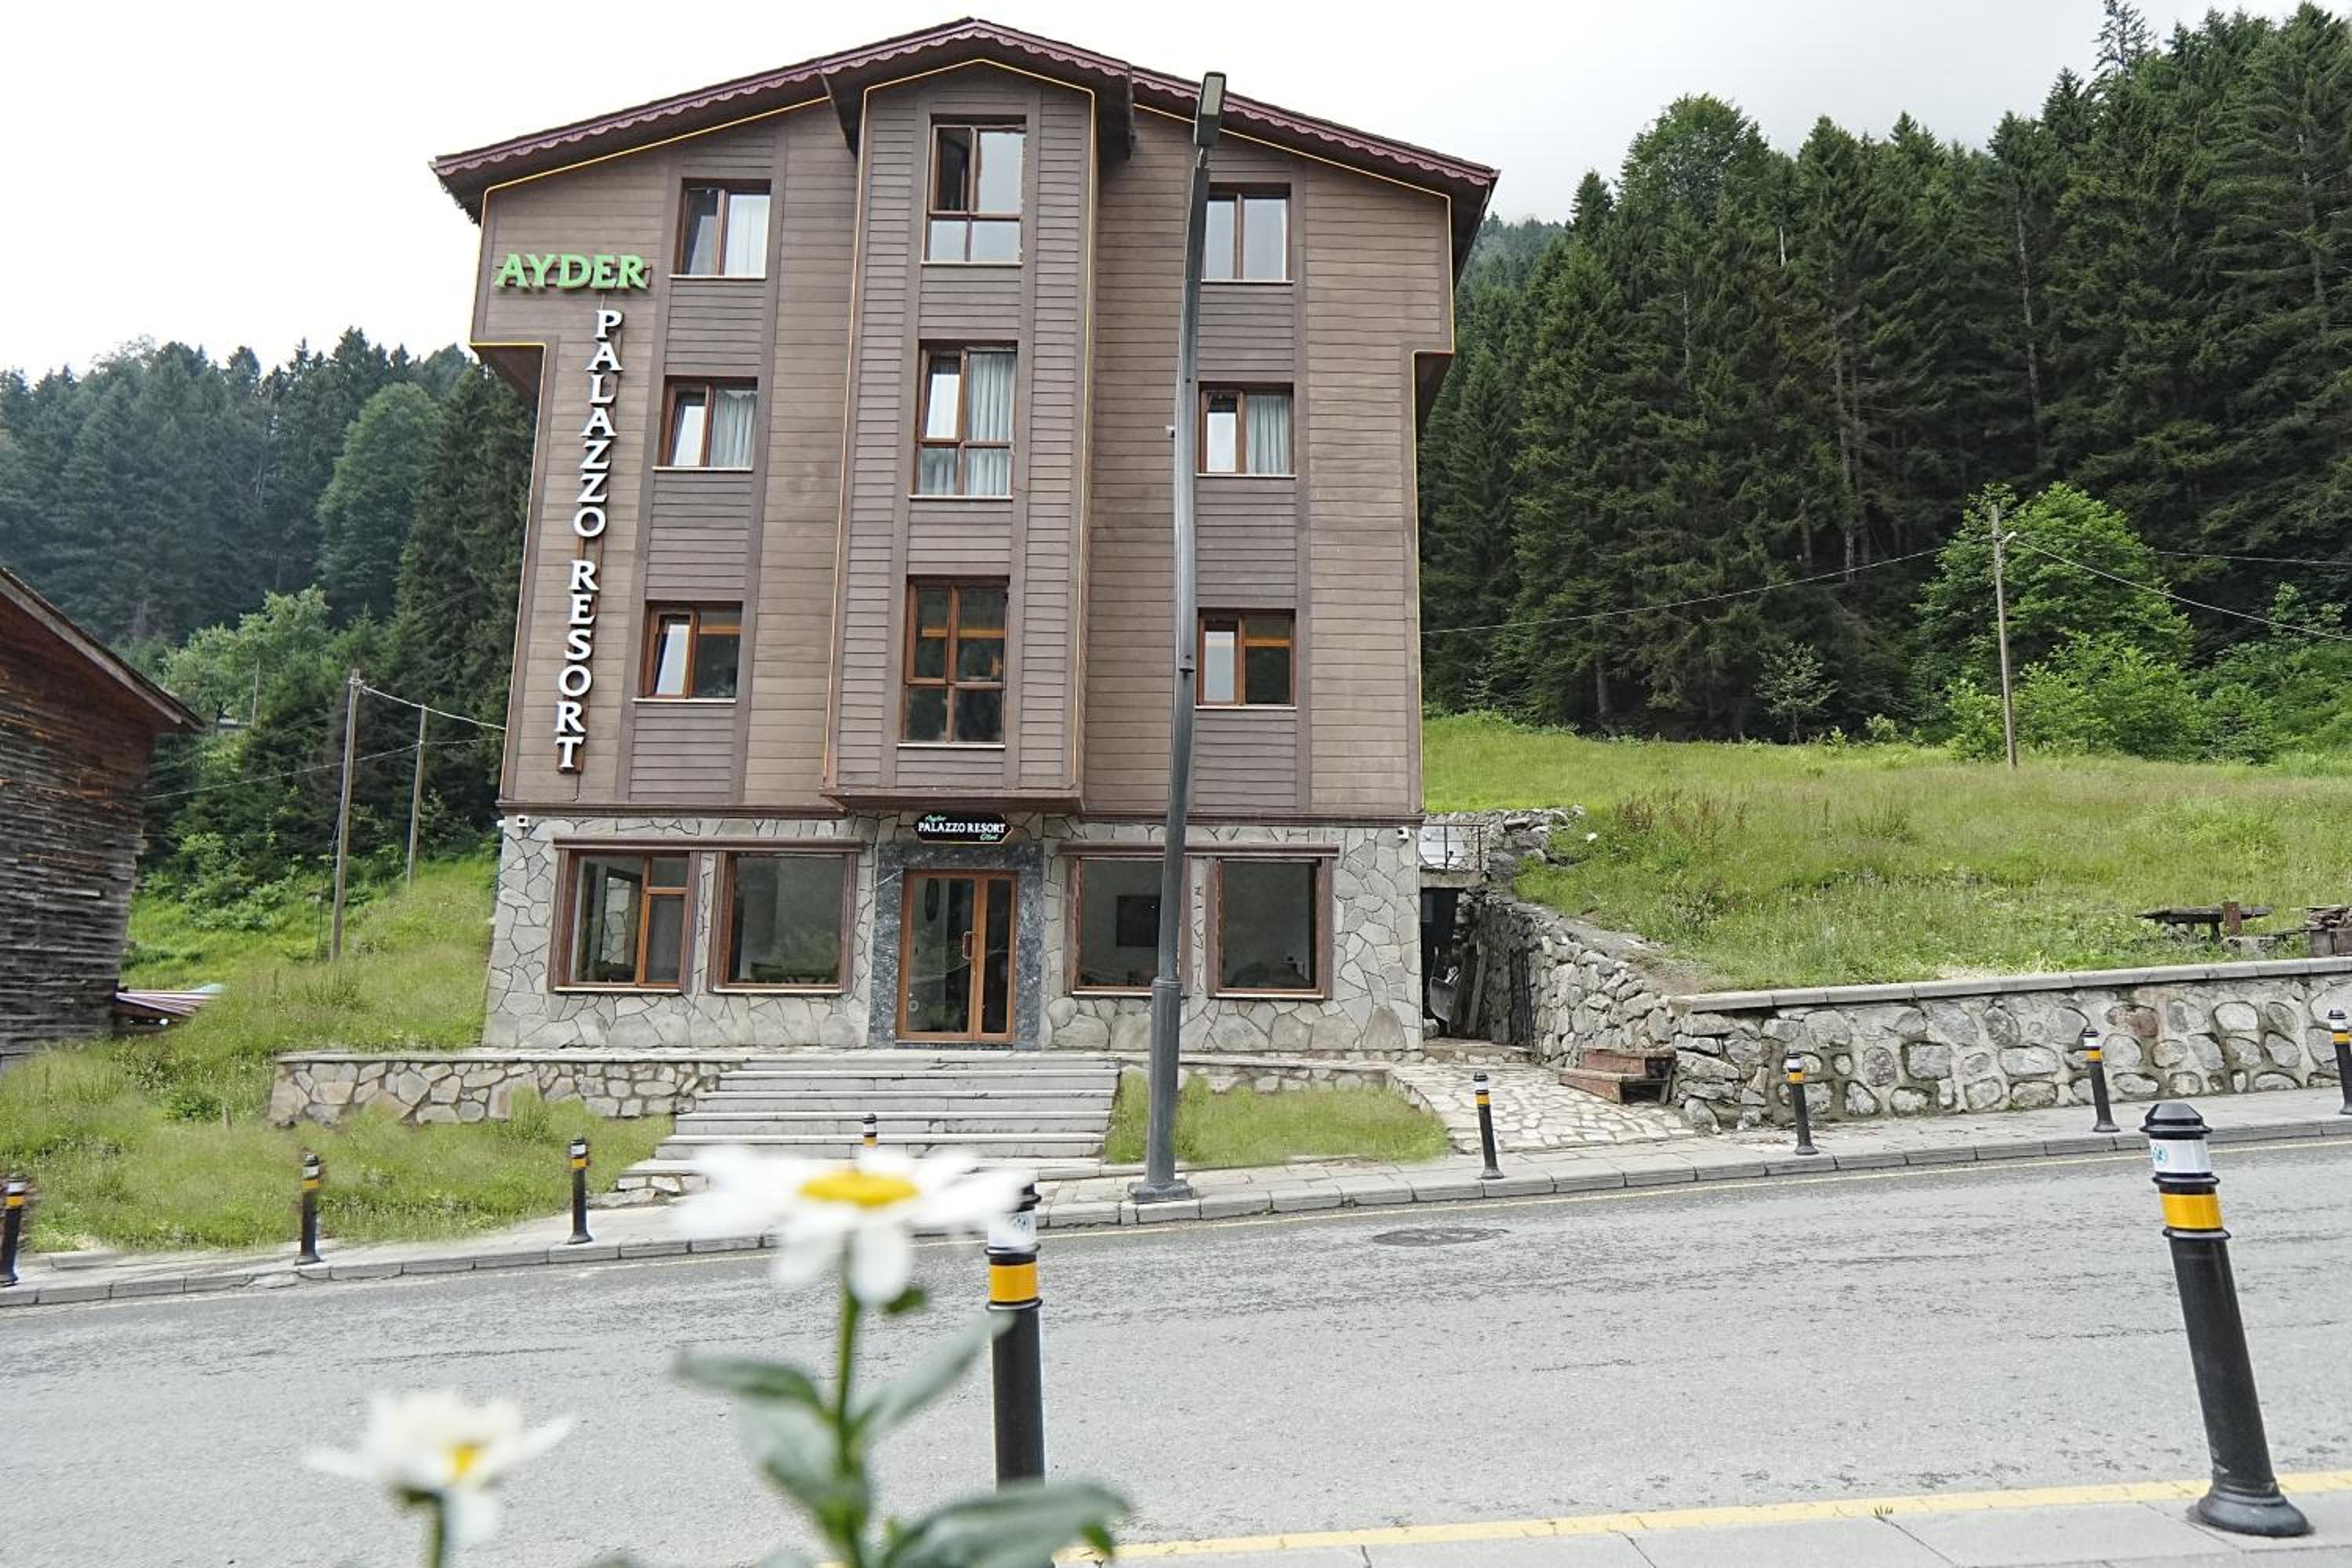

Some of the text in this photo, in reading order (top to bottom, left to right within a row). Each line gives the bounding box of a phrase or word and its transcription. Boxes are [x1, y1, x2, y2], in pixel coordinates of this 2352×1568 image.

[494, 253, 649, 289] AYDER
[554, 310, 623, 769] PALAZZO RESORT
[918, 822, 1006, 833] PALAZZO RESORT
